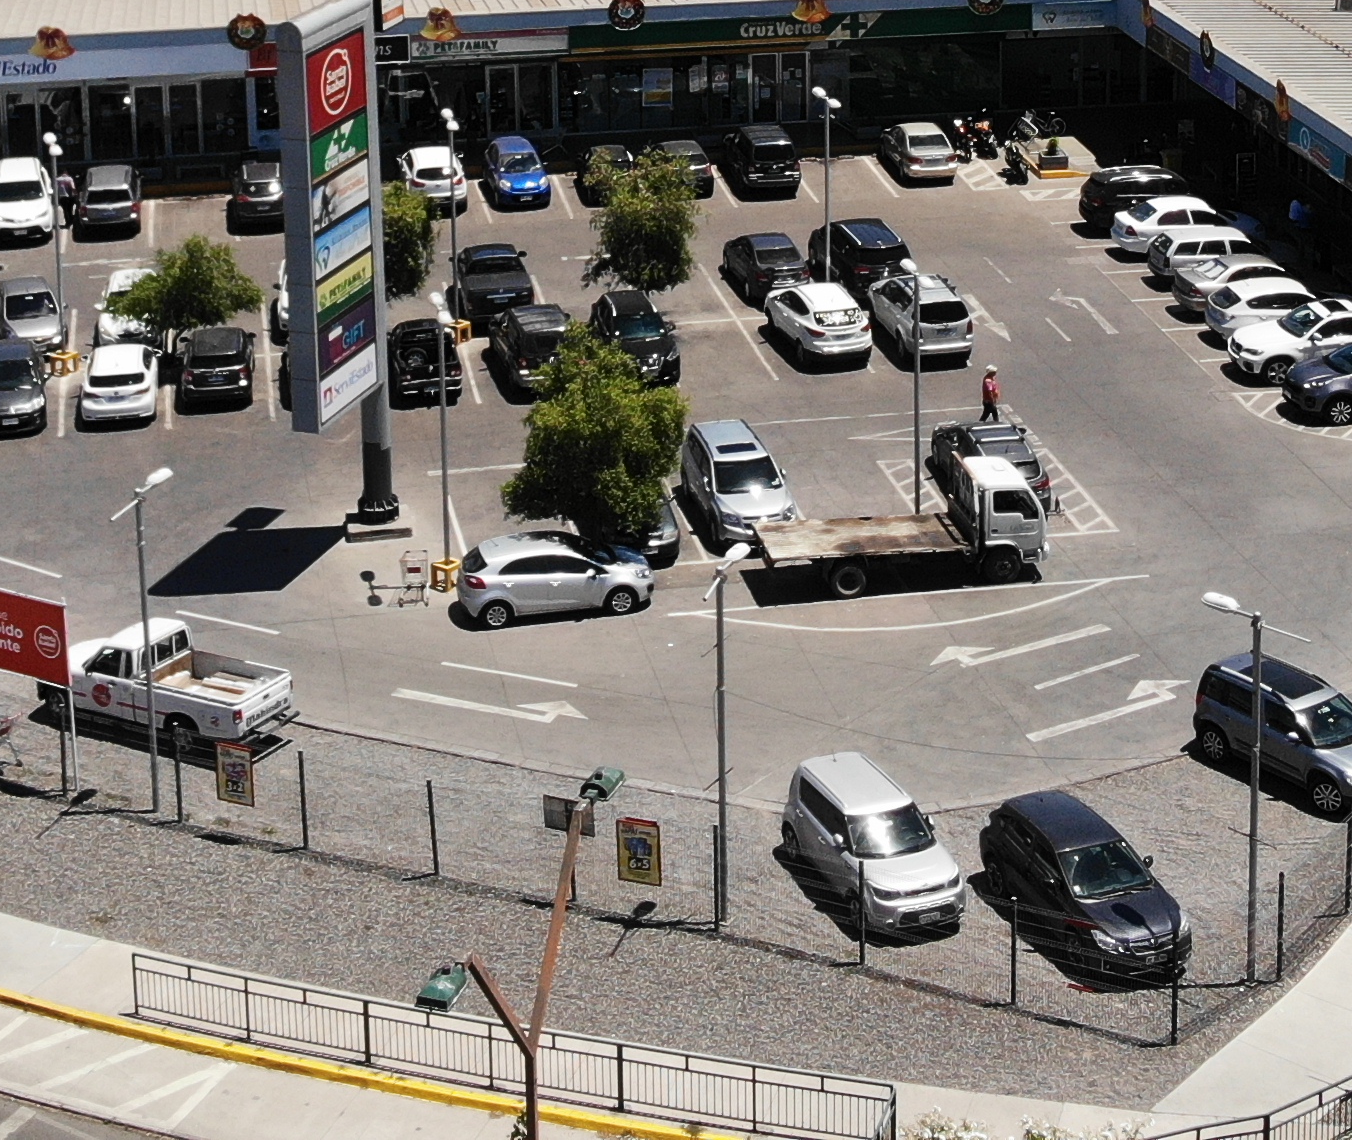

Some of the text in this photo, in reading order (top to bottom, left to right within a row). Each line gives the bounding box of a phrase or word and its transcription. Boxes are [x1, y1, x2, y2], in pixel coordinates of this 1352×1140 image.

[740, 21, 822, 38] Cruz Verde
[342, 319, 365, 349] GIFT
